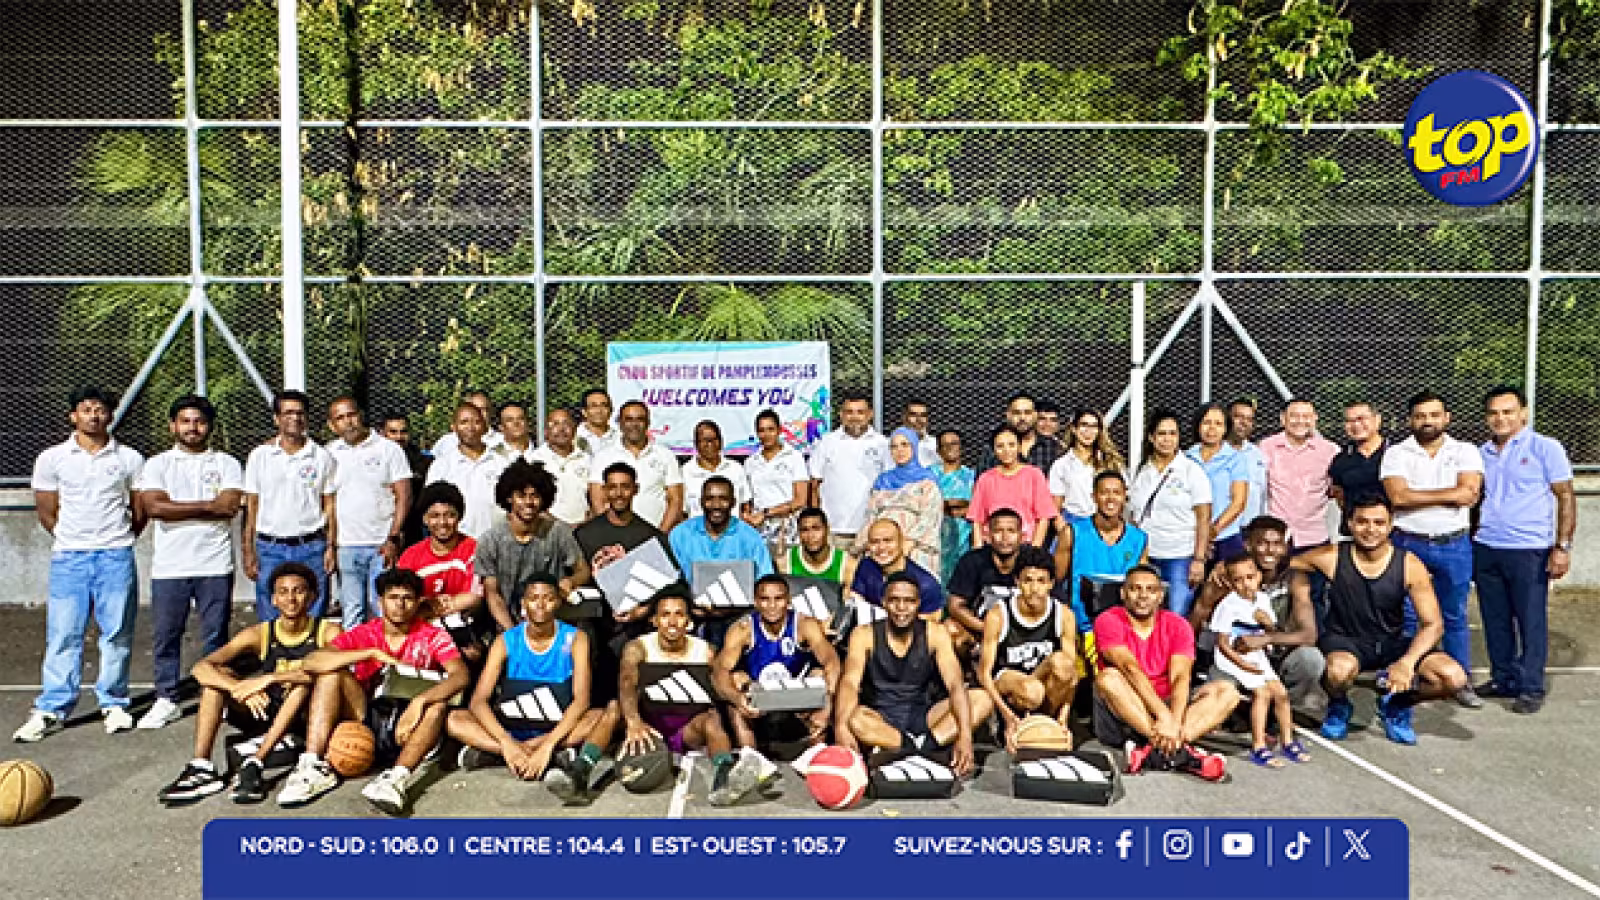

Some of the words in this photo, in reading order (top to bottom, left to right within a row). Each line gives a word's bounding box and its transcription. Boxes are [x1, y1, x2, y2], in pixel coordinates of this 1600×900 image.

[701, 363, 717, 380] DE
[642, 388, 755, 407] WELCOMES
[757, 388, 796, 406] YOU
